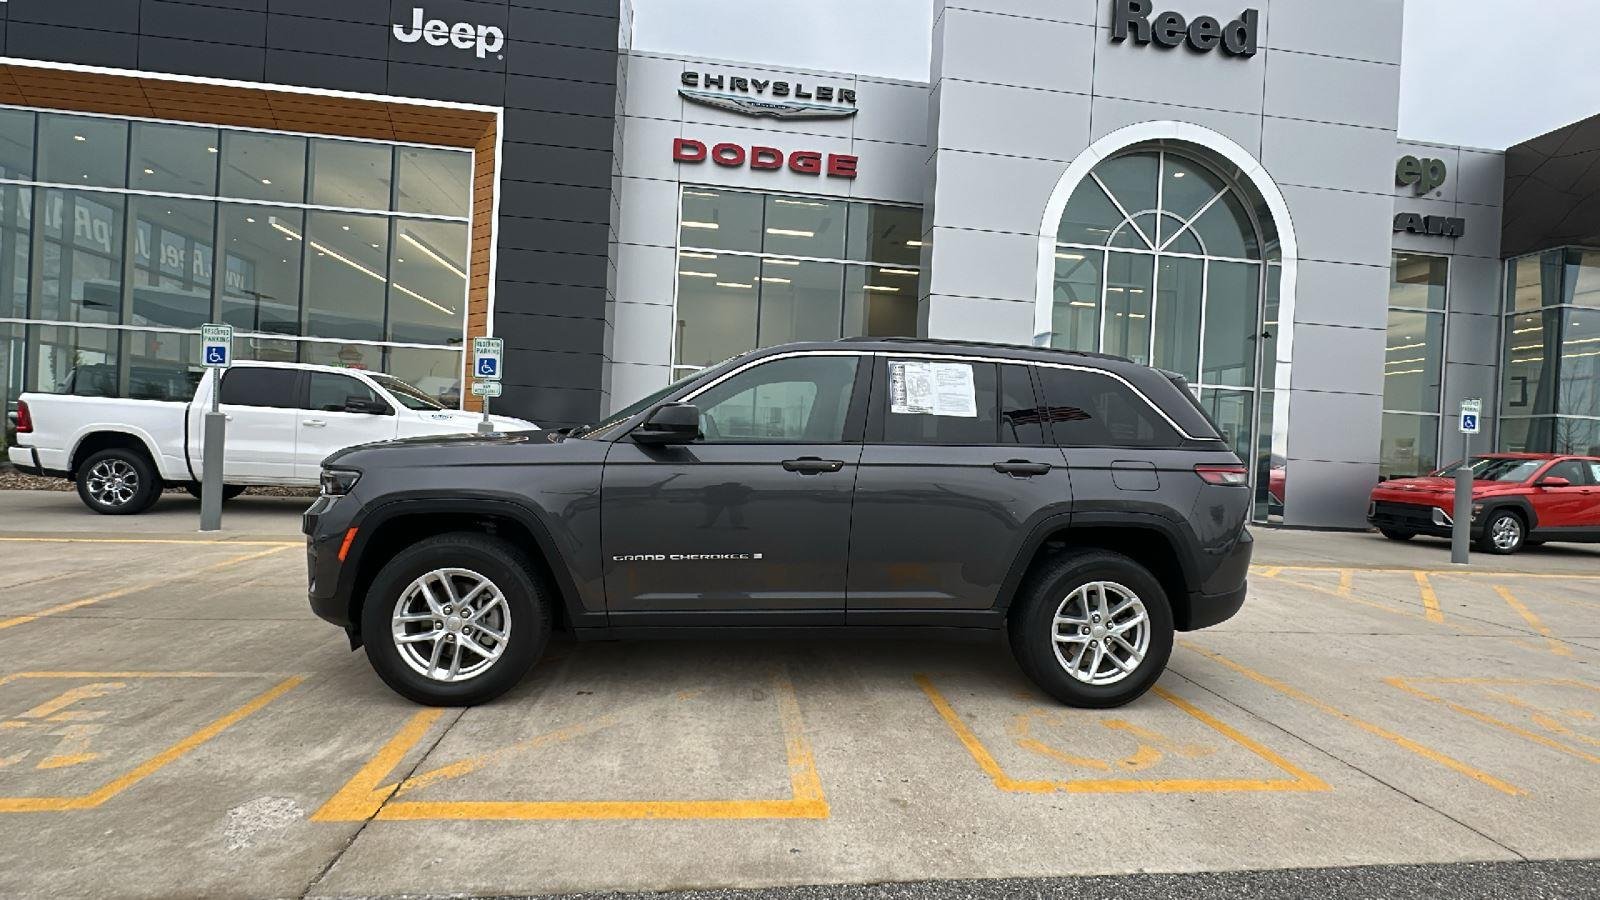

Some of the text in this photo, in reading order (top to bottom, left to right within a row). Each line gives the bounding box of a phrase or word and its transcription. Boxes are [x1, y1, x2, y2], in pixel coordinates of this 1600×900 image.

[392, 7, 504, 59] Jeep
[1112, 0, 1258, 57] Reed
[681, 71, 857, 103] CHRYSLER
[673, 138, 859, 179] DODGE
[1393, 212, 1465, 237] AM
[612, 553, 666, 561] GRAND
